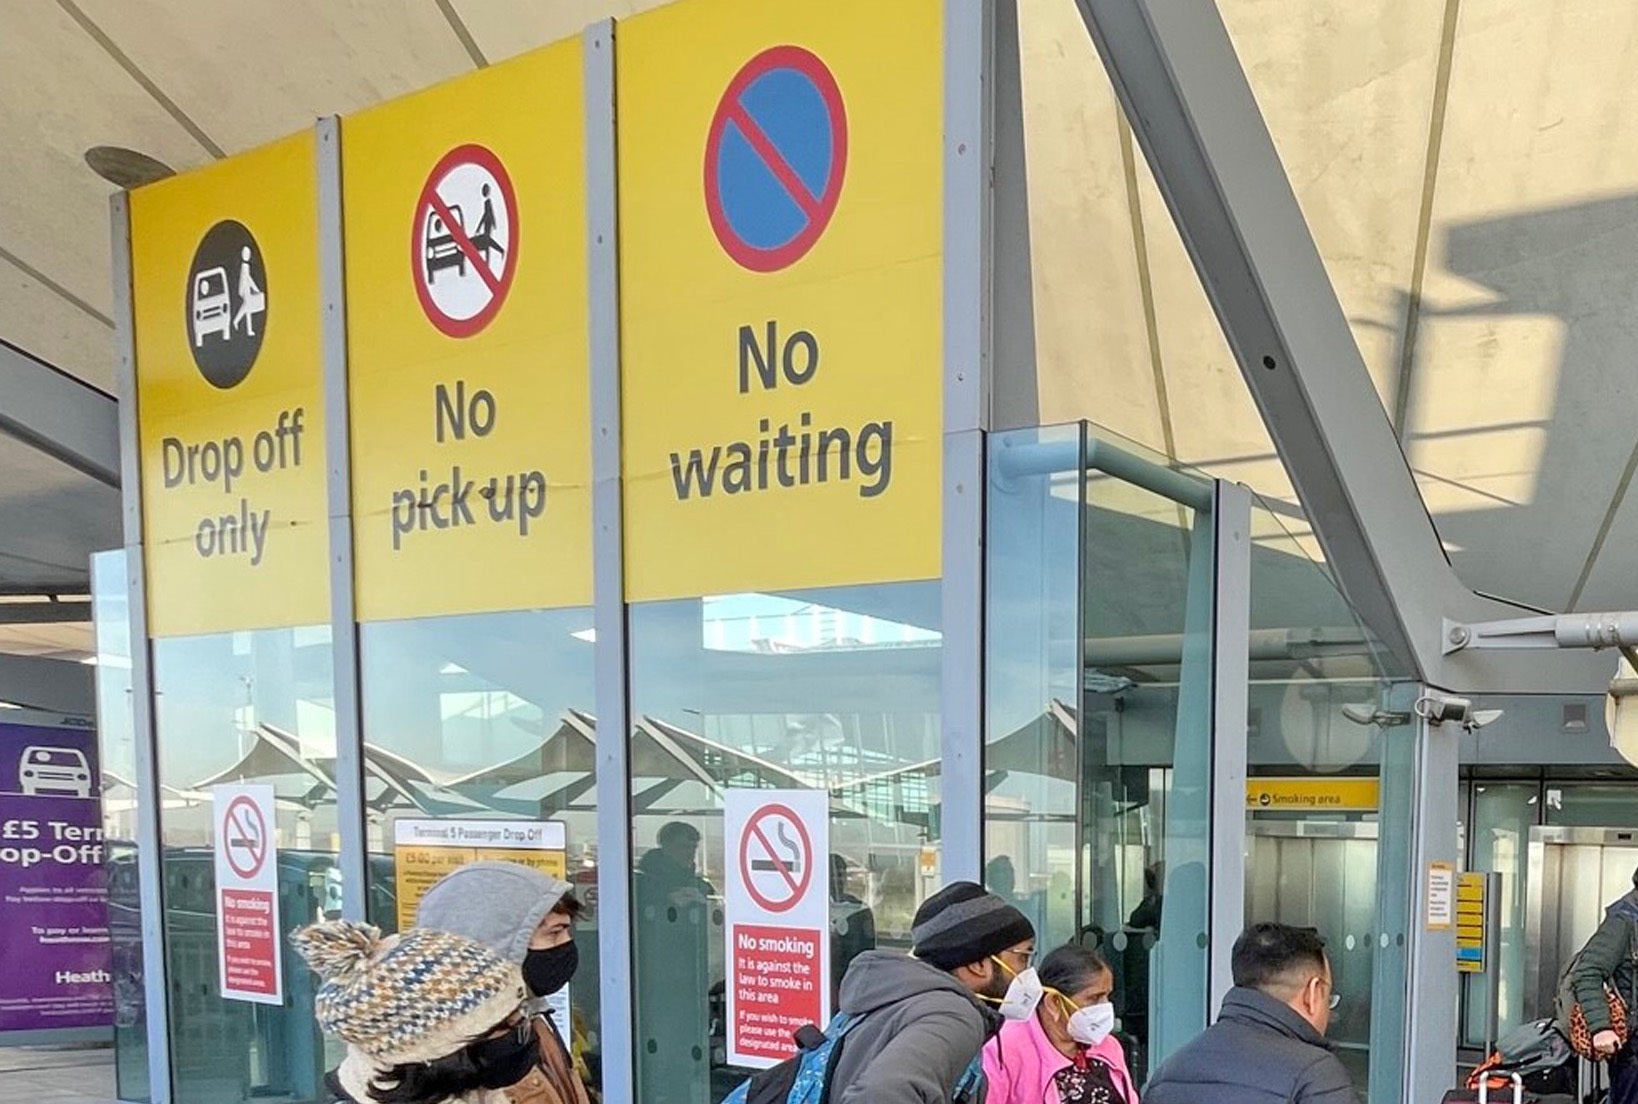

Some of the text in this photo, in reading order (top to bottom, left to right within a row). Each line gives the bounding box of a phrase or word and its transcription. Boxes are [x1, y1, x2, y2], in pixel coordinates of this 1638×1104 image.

[739, 320, 819, 394] No
[435, 380, 496, 443] No
[162, 407, 304, 494] Drop off
[670, 412, 893, 500] waiting
[392, 466, 547, 550] pick up
[196, 498, 270, 566] only
[1273, 794, 1341, 806] Smoking area
[2, 820, 40, 840] £5
[738, 933, 814, 959] No smoking
[55, 969, 111, 983] Heath
[739, 957, 810, 975] It is against the
[739, 972, 813, 991] law to smoke in
[739, 988, 779, 1004] this area
